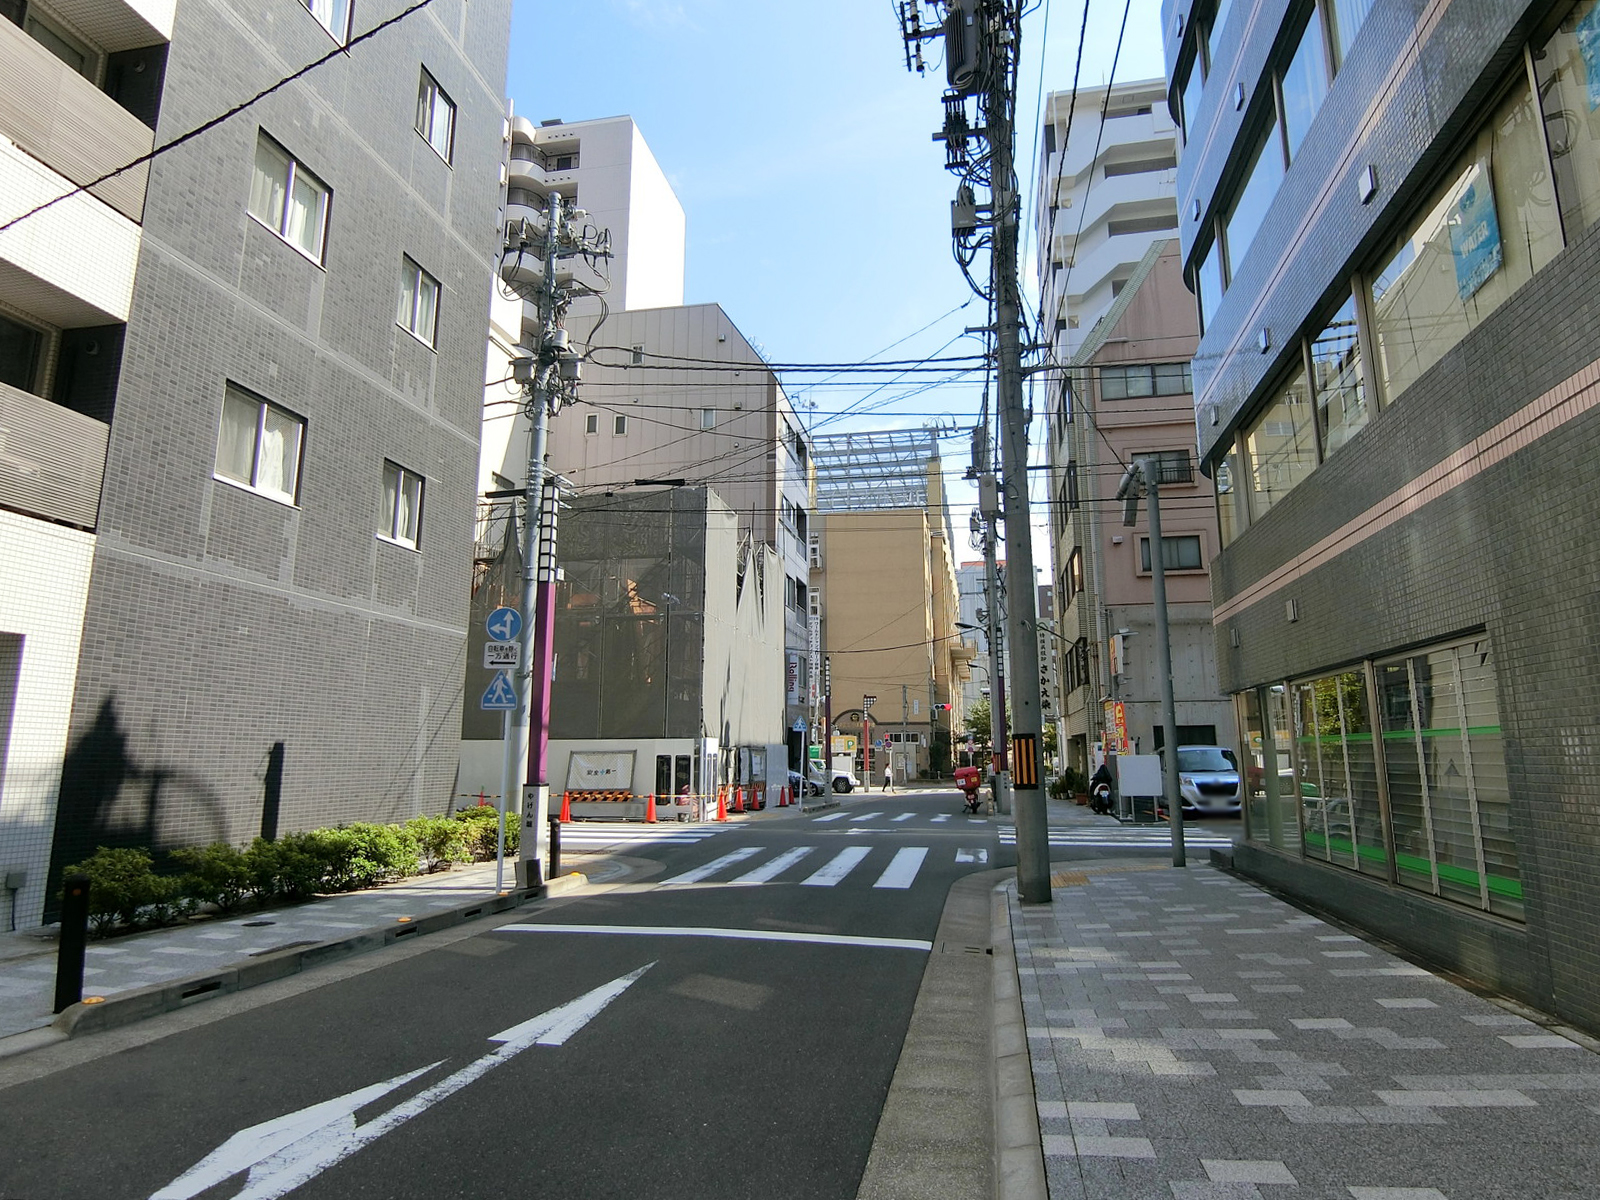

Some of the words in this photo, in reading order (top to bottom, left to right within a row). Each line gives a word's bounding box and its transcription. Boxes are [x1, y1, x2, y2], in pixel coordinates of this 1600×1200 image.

[1460, 220, 1489, 258] WATER
[488, 645, 518, 653] 自転車を除く
[488, 652, 517, 660] 一方通行
